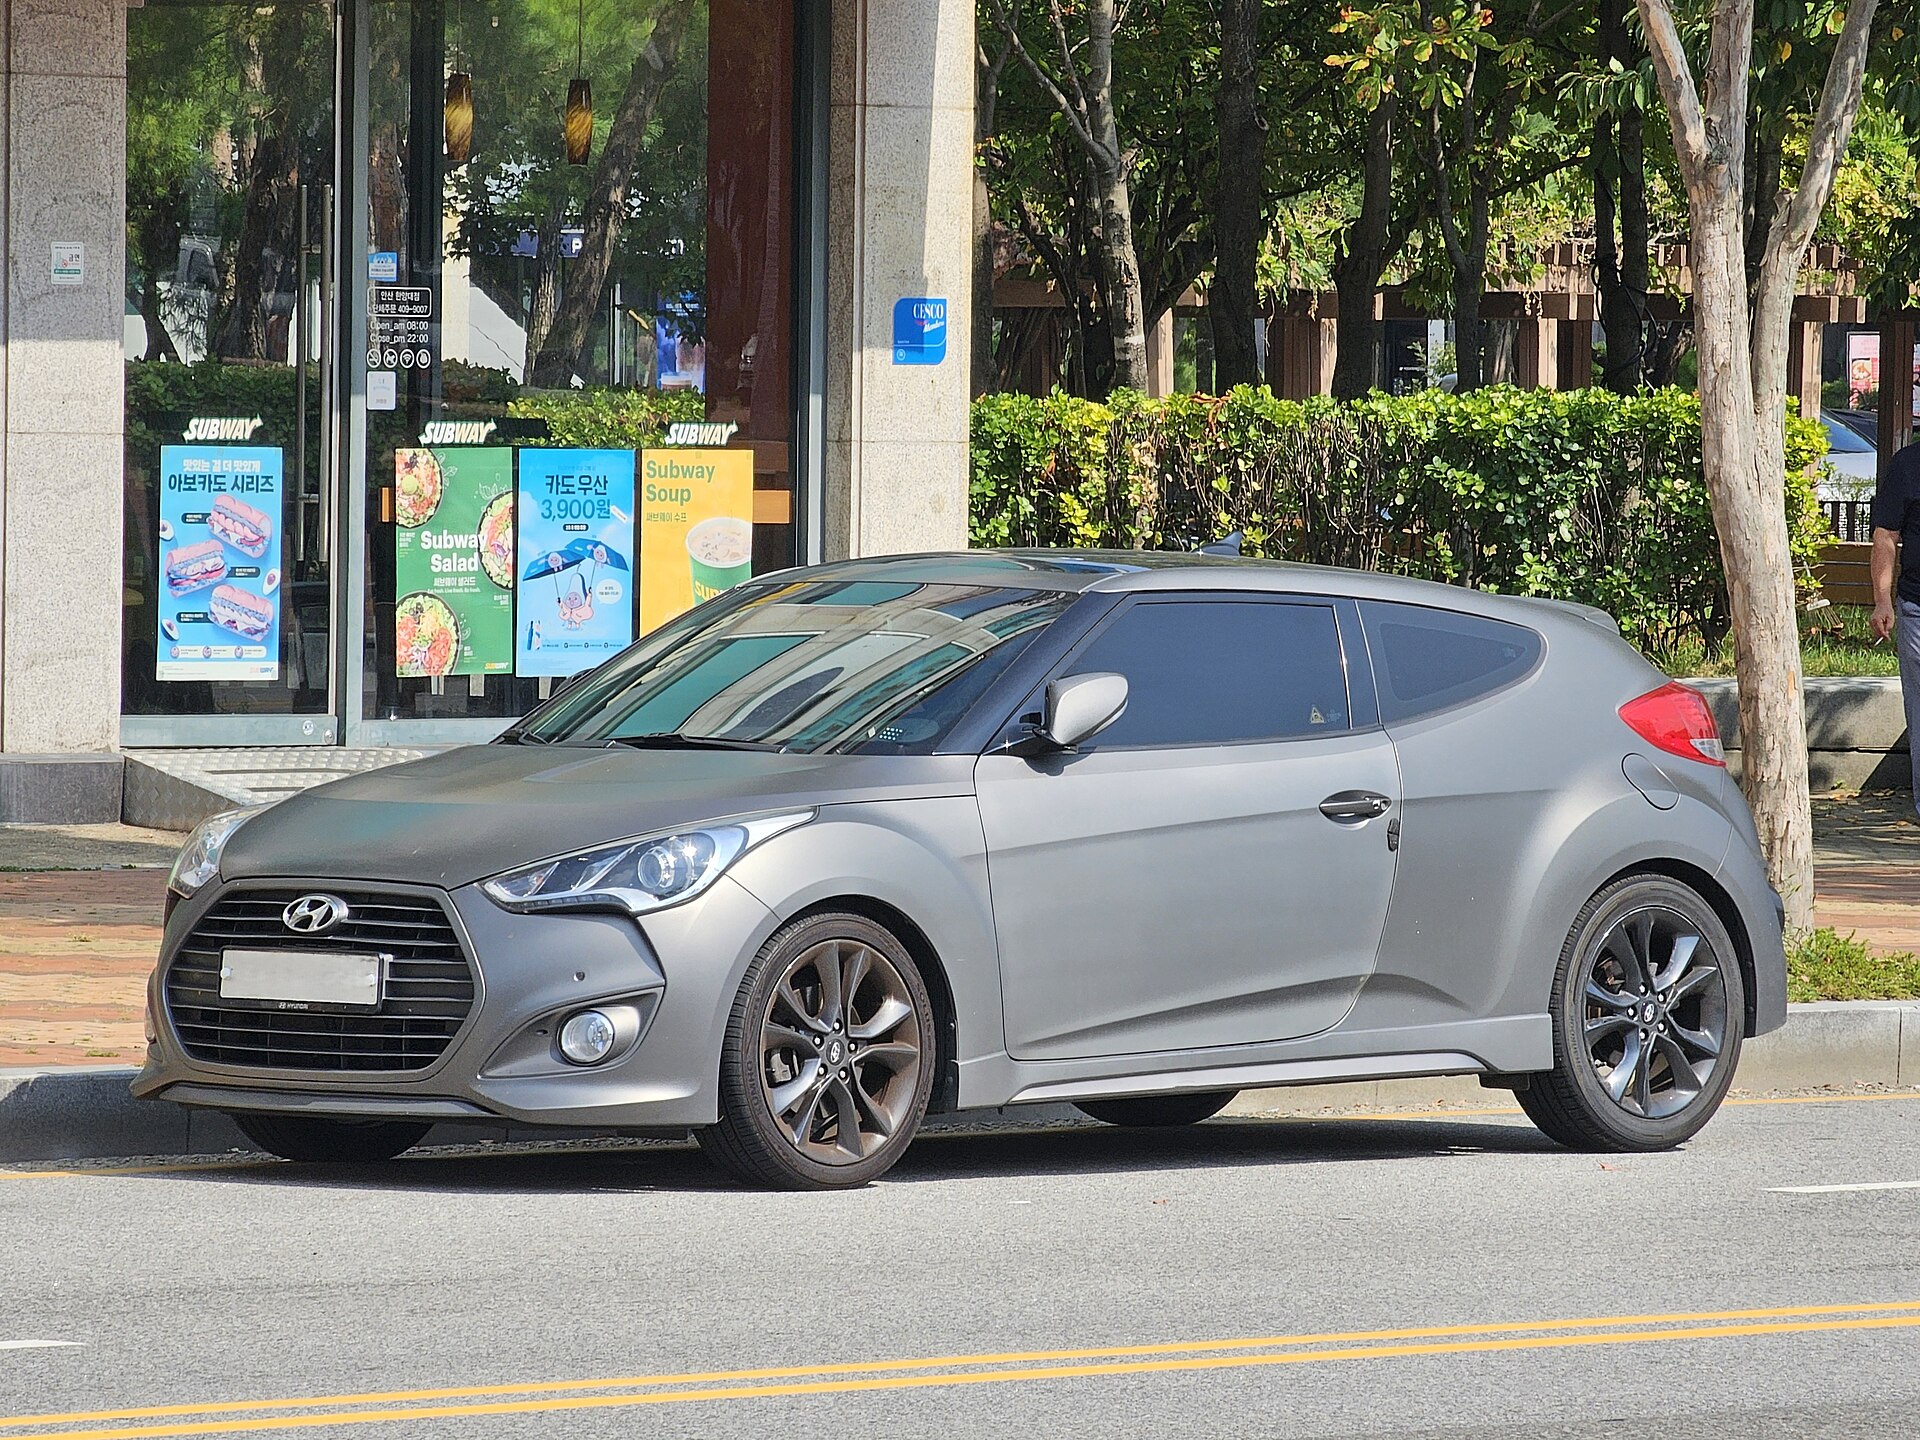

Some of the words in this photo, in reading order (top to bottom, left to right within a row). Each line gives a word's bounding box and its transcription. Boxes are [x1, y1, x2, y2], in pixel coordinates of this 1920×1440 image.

[380, 291, 394, 301] 안산
[398, 304, 429, 314] 409-9007
[913, 303, 944, 319] CESCO
[406, 321, 429, 331] 08:00
[407, 334, 429, 343] 22:00
[183, 415, 262, 441] SUBWAY
[418, 420, 497, 445] SUBWAY
[664, 421, 738, 446] SUBWAY
[646, 460, 715, 483] Subway
[168, 473, 227, 493] 아보카도
[231, 474, 275, 493] 시리즈
[545, 475, 576, 496] 카도
[577, 475, 608, 496] 우산
[646, 484, 692, 507] Soup
[541, 499, 611, 522] 3,900원
[420, 530, 488, 551] Subway
[430, 552, 480, 573] Salad
